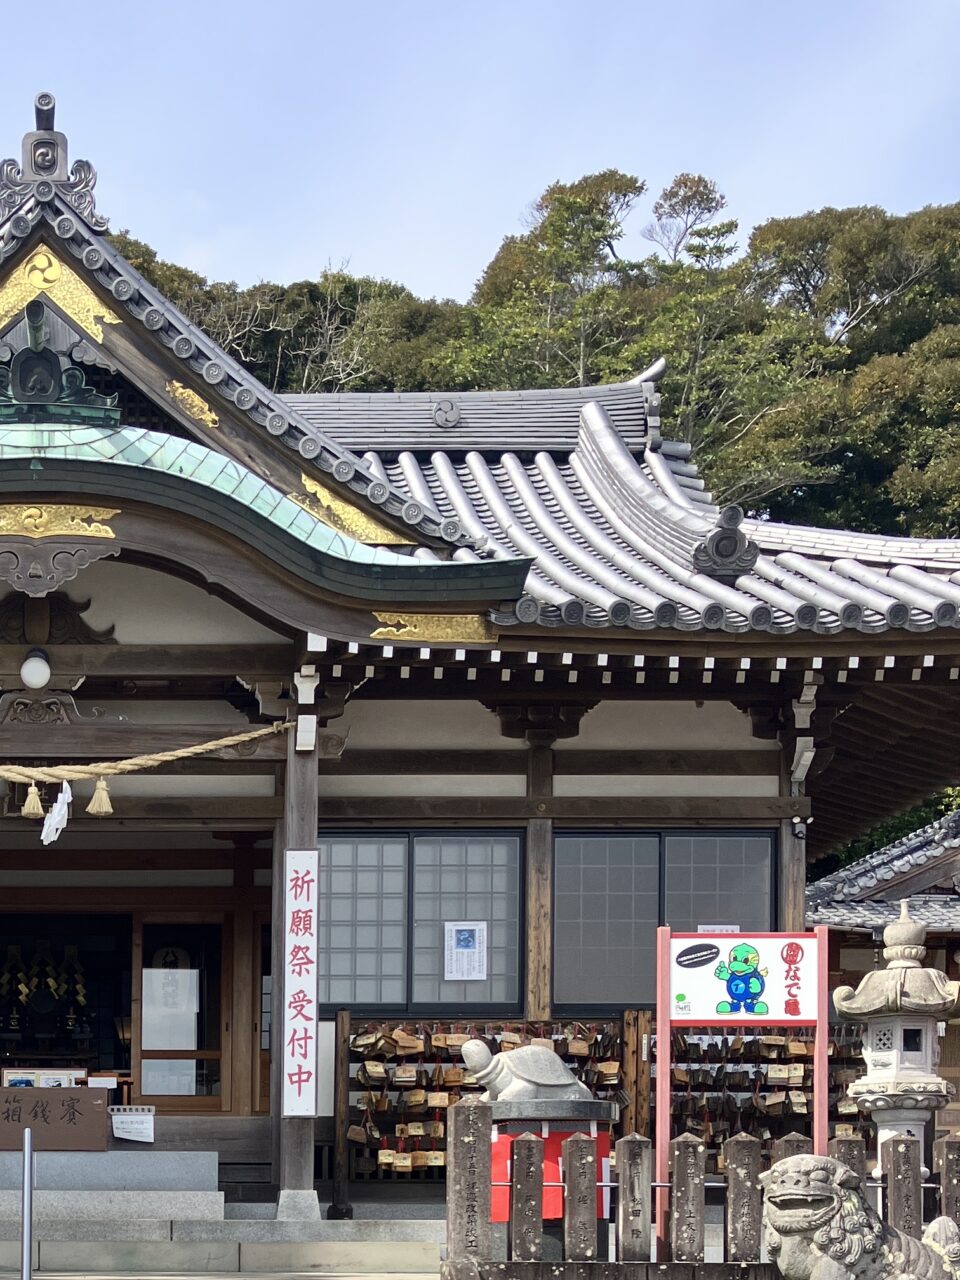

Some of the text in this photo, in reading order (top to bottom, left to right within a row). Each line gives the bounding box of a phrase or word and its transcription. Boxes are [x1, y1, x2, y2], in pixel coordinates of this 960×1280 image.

[287, 869, 315, 1098] 祈願祭受付中
